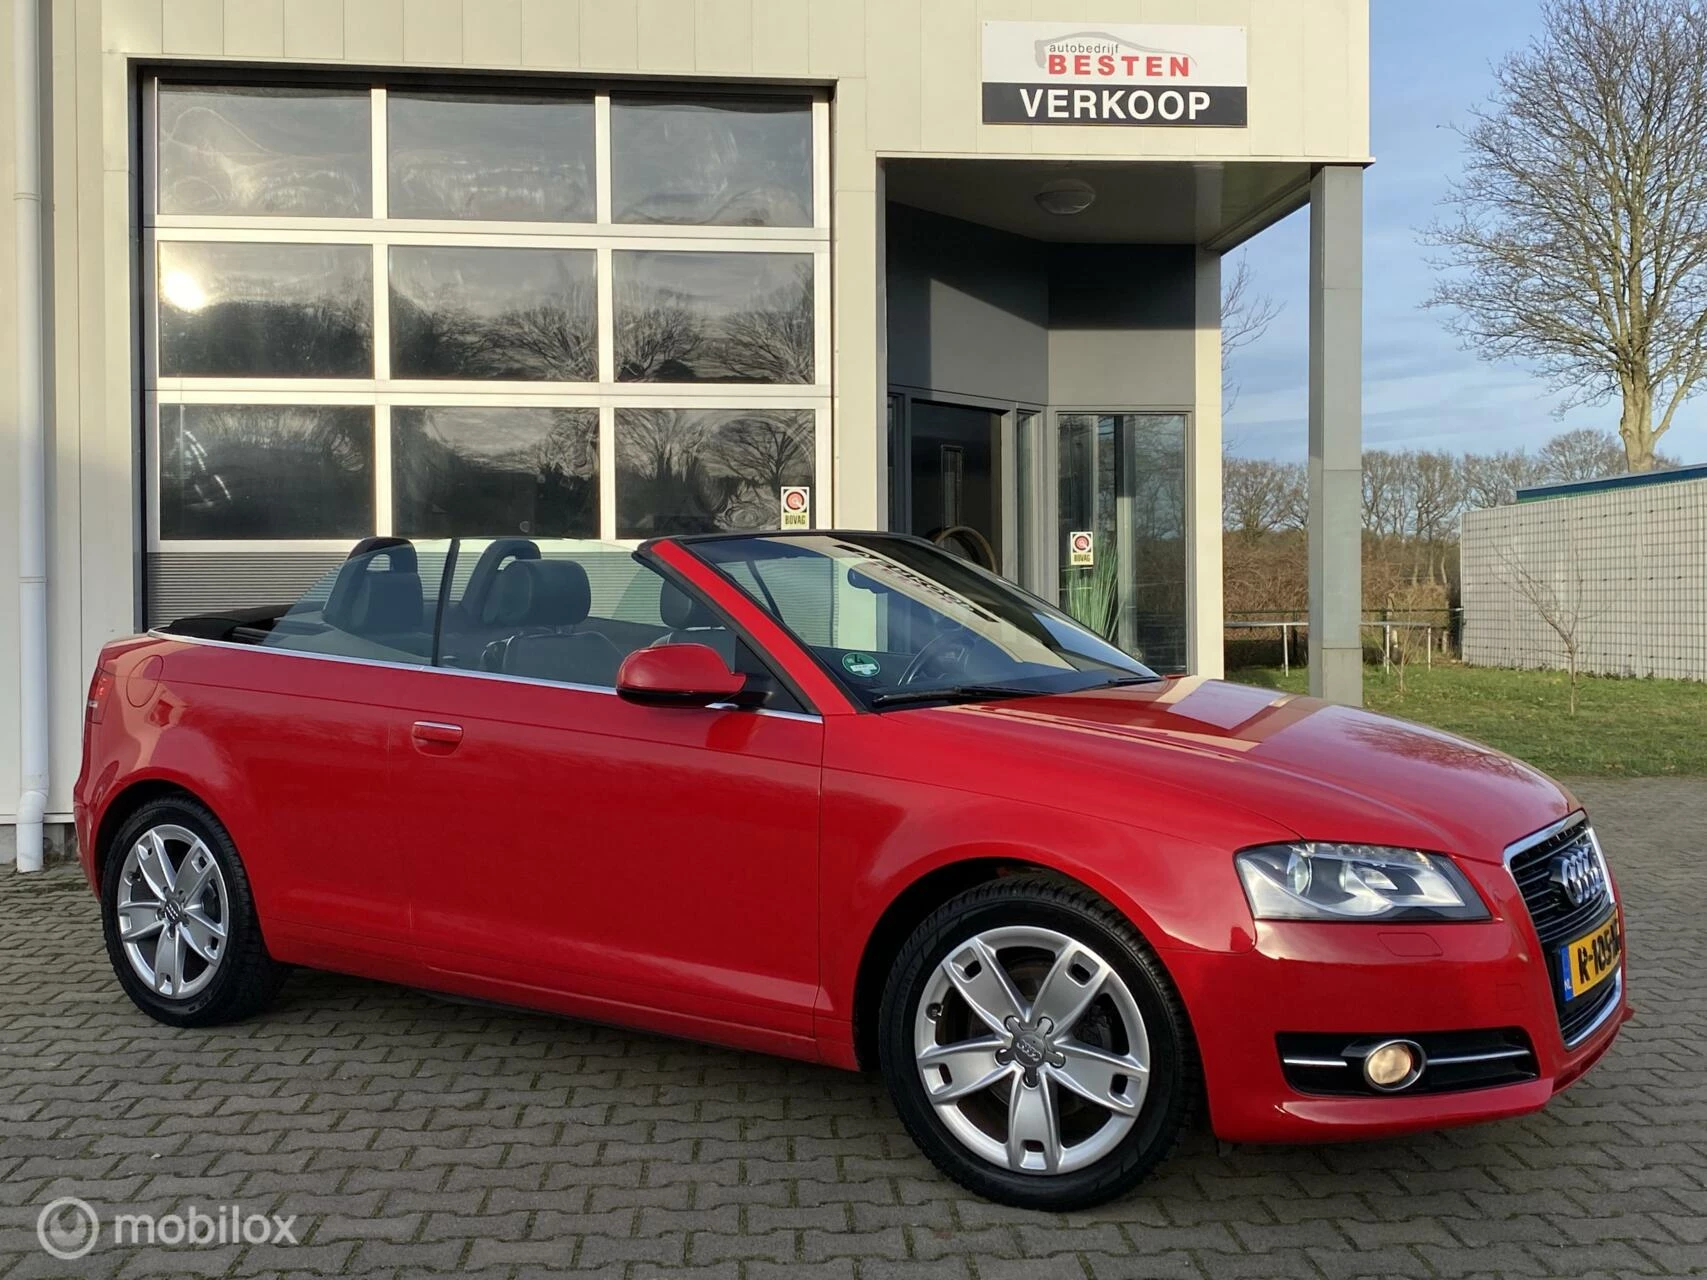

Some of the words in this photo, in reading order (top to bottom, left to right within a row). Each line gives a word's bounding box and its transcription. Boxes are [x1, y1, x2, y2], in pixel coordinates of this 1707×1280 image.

[1049, 43, 1119, 56] autobedrijf
[1048, 54, 1190, 77] BESTEN
[1019, 88, 1211, 120] VERKOOP
[785, 514, 806, 525] BOVAG
